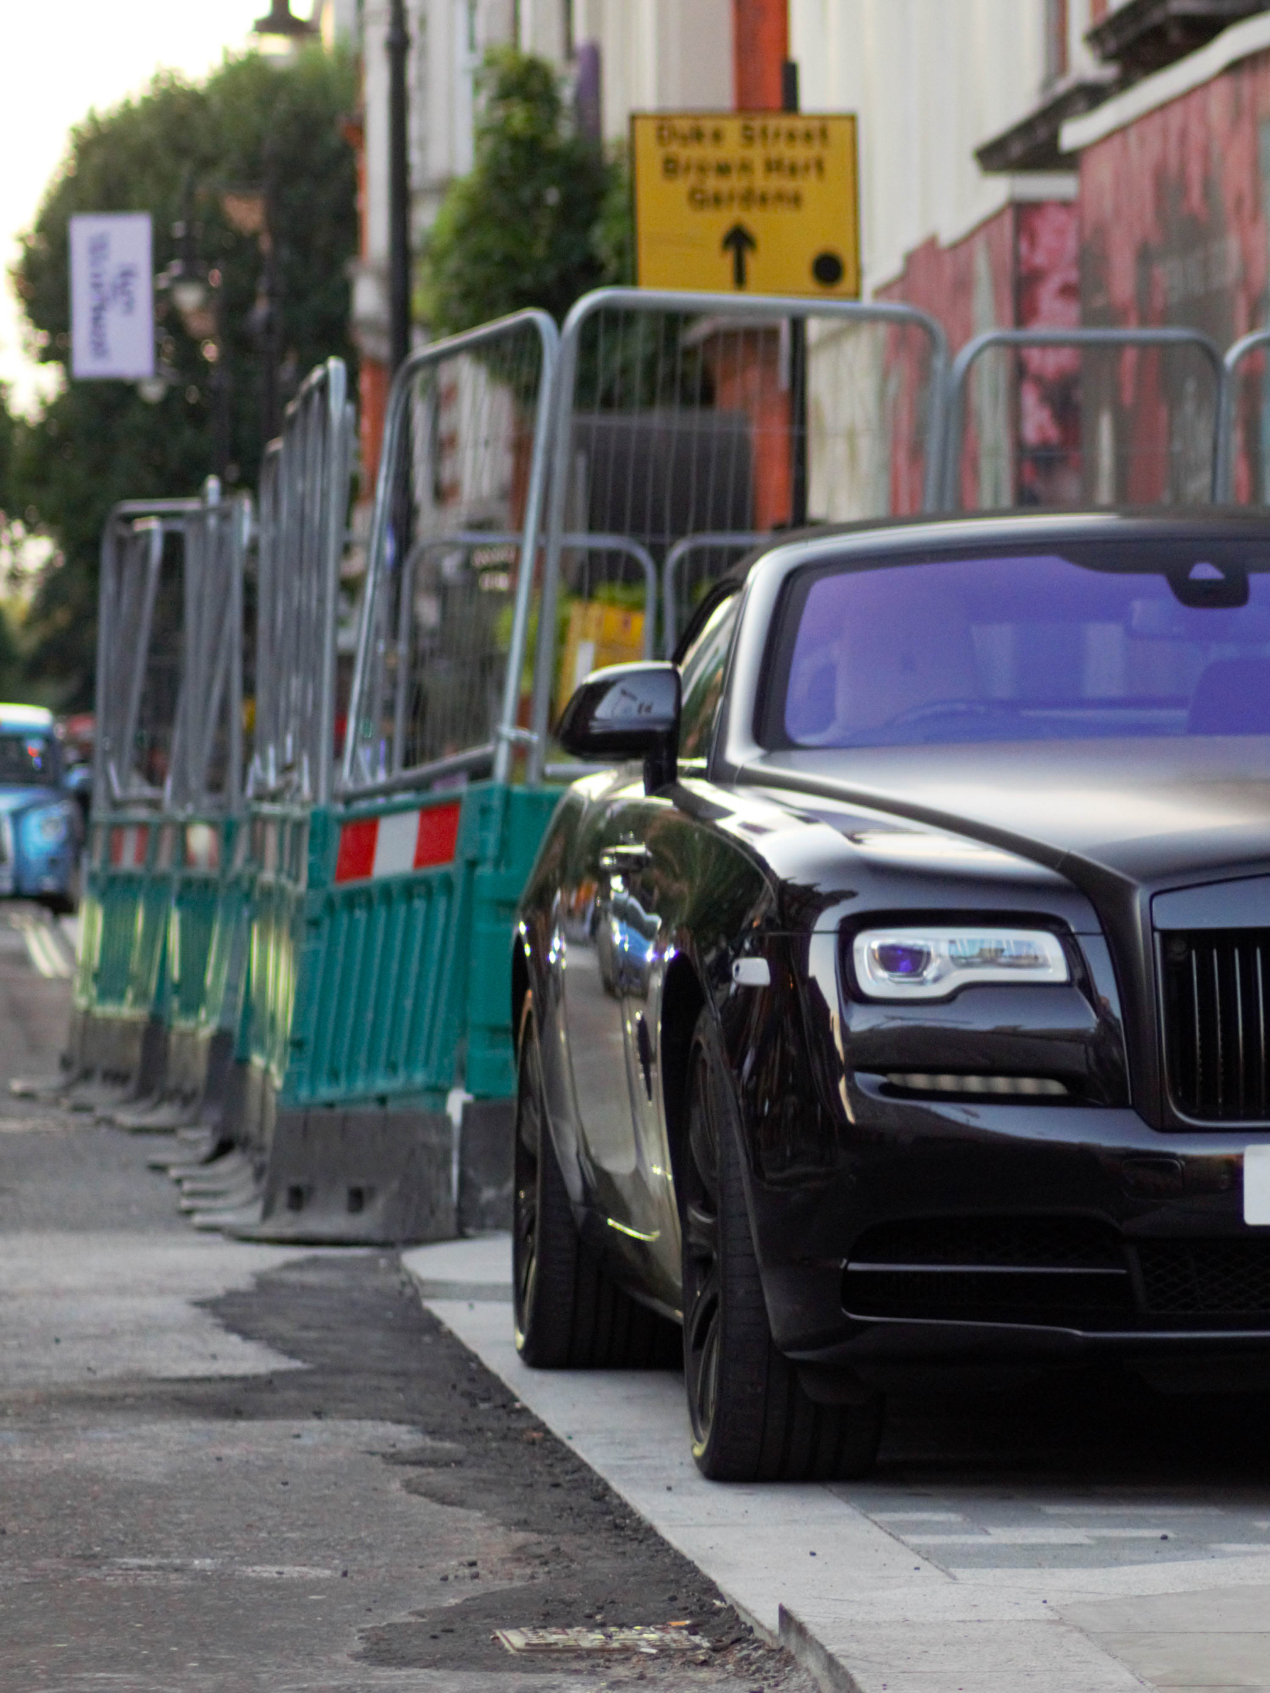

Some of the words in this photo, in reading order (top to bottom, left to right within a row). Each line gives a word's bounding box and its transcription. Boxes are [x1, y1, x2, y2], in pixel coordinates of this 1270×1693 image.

[656, 123, 722, 146] Duke
[741, 123, 827, 146] Street
[662, 154, 752, 180] Brown
[765, 154, 825, 180] Hart
[688, 186, 802, 211] Gardens
